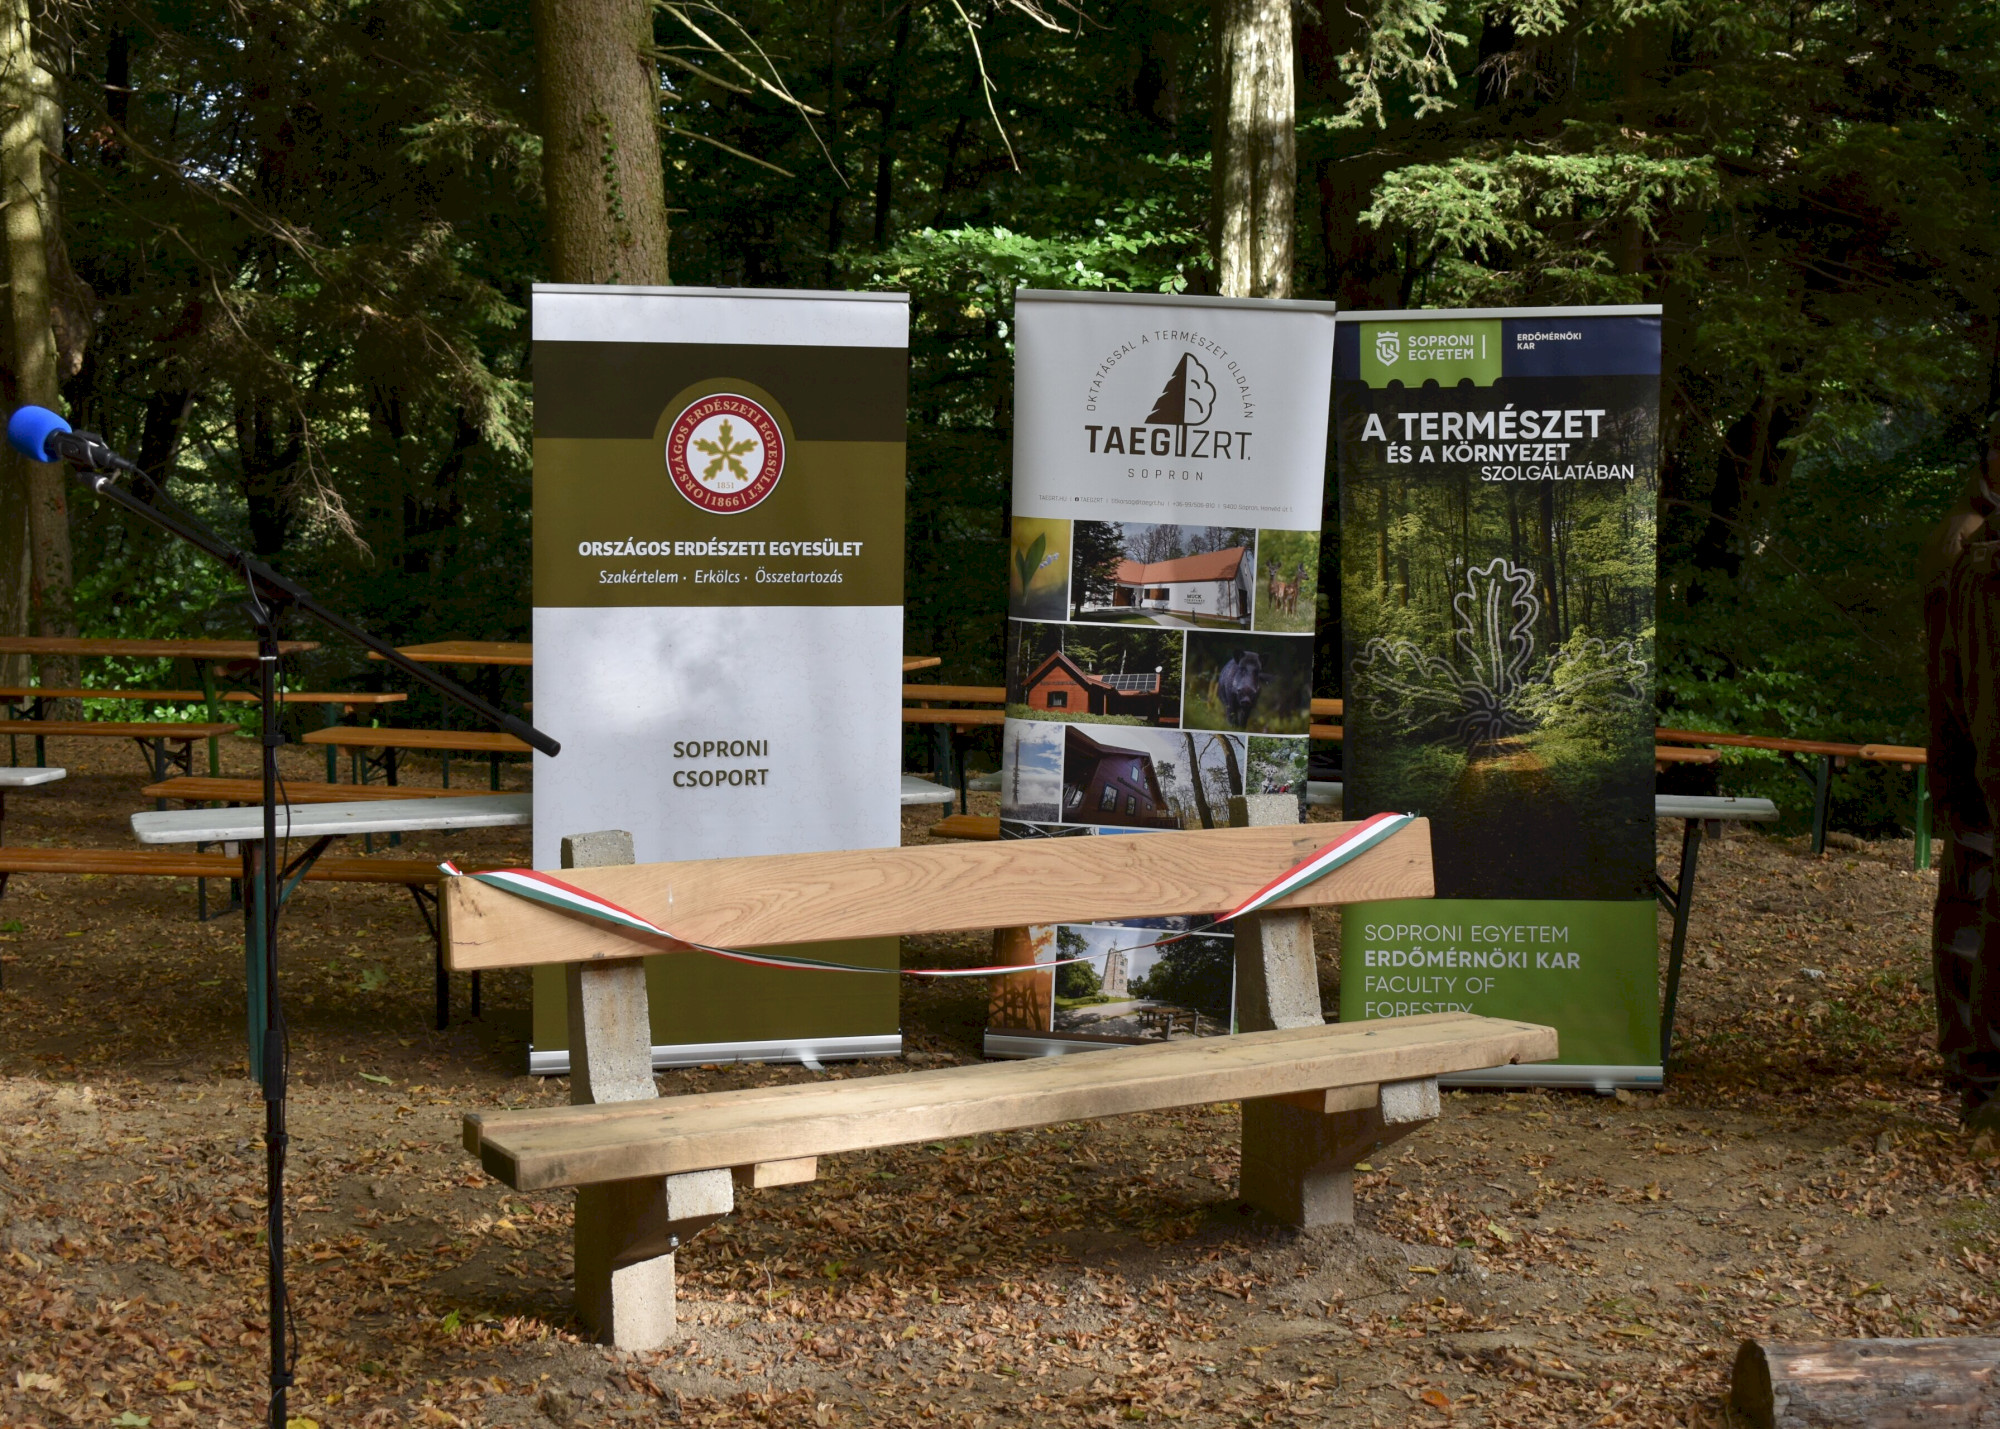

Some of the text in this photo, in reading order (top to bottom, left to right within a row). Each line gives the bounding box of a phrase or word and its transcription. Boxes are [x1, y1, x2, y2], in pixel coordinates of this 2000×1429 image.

[1408, 334, 1474, 347] SOPRONI
[1517, 332, 1582, 342] ERDŐMÉRNÖKI
[1517, 342, 1535, 350] KAR
[1408, 349, 1474, 361] EGYETEM
[1087, 330, 1256, 419] OKTATÁSSAL A TERMÉSZET OLDALÁN
[1360, 403, 1605, 442] A TERMÉSZET
[671, 399, 778, 500] ORSZÁGOS ERDÉSZETI EGYESÜLET
[1386, 440, 1570, 464] ÉS A KÖRNYEZET
[1128, 468, 1203, 481] SOPRON
[1481, 460, 1634, 481] SZOLGÁLATÁBAN
[711, 496, 740, 507] 1866
[578, 536, 863, 557] ORSZÁGOS ERDÉSZETI EGYESÜLET
[599, 566, 843, 584] Szakértelem Erkölcs Összetartozás
[673, 740, 768, 758] SOPRONI
[673, 768, 769, 787] CSOPORT
[1364, 924, 1569, 943] SOPRONI EGYETEM
[1364, 946, 1581, 970] ERDŐMÉRNÖKI KAR
[1365, 975, 1495, 994] FACULTY OF
